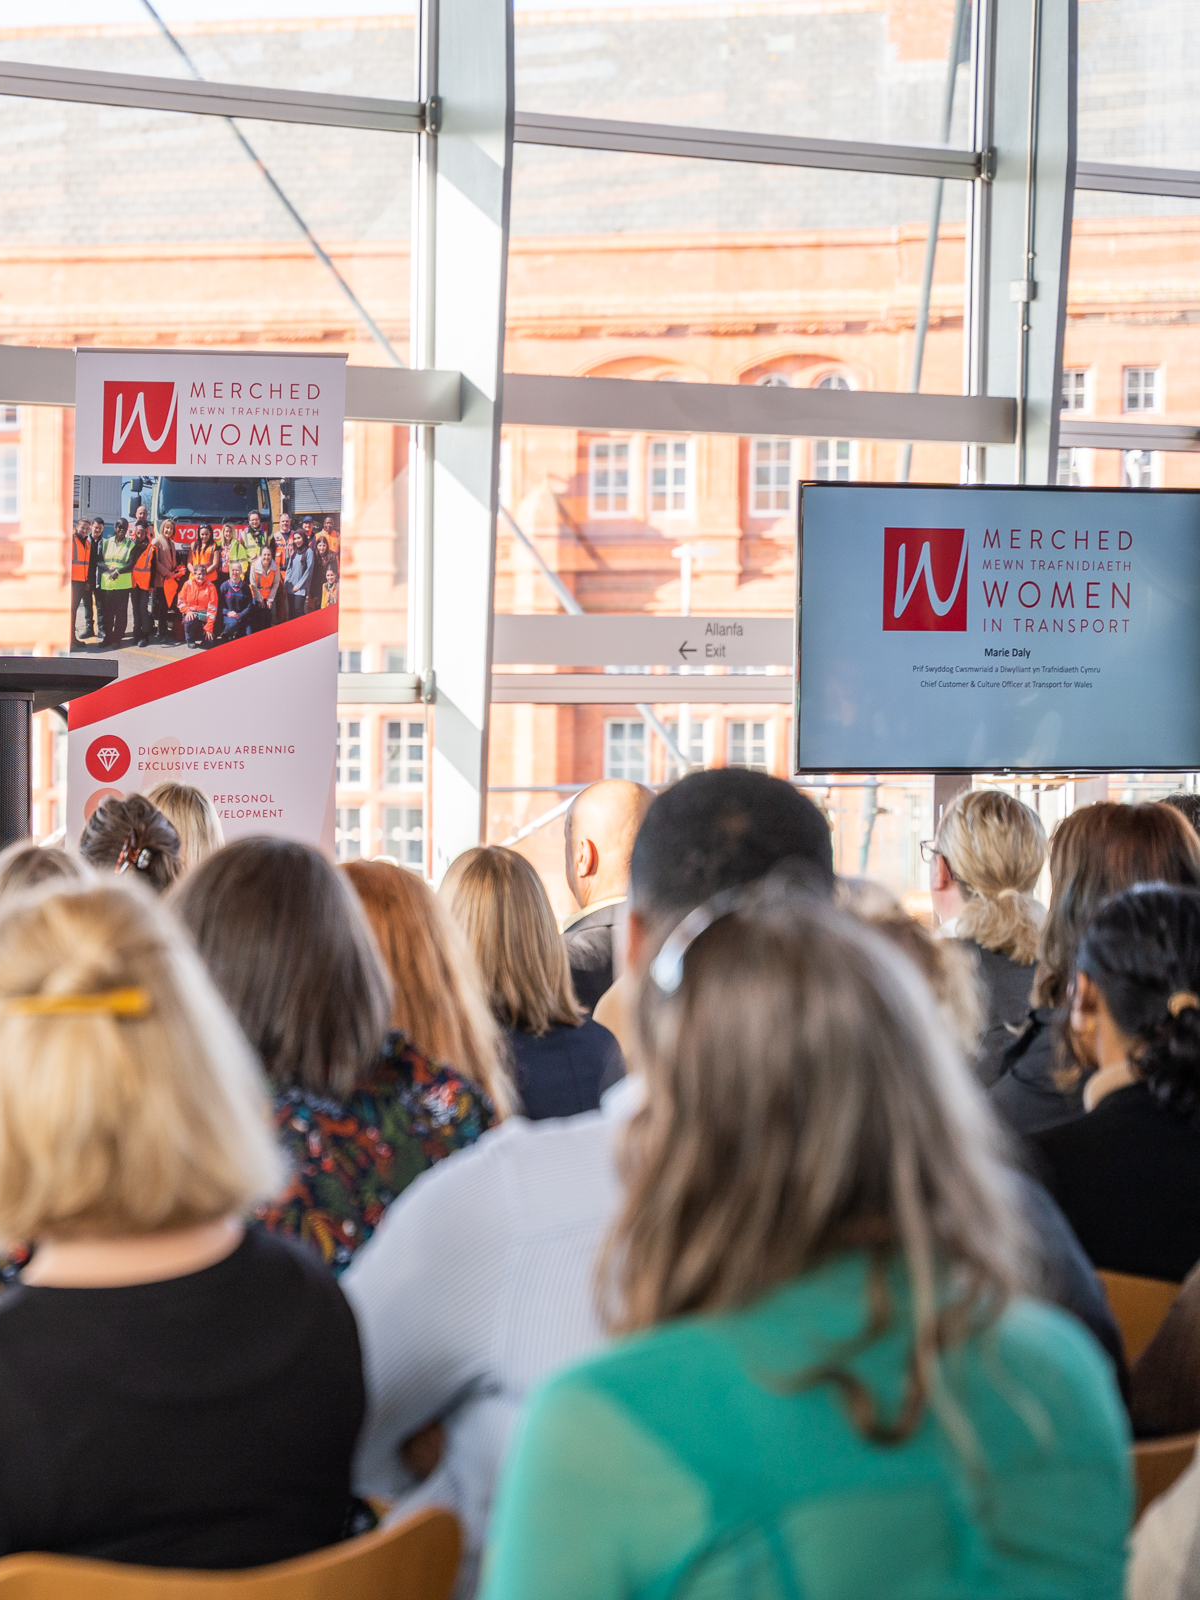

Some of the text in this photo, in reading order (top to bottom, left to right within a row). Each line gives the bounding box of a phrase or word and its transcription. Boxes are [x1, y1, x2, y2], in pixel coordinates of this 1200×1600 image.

[190, 382, 320, 400] MERCHED
[190, 407, 319, 417] MEWN TRAFNIDIAETH
[190, 424, 319, 446] WOMEN
[190, 454, 318, 466] IN TRANSPORT
[983, 528, 1133, 550] MERCHED
[982, 560, 1131, 571] MEWN TRAFNIDIAETH
[983, 580, 1131, 609] WOMEN
[705, 622, 743, 637] Allanfa
[983, 618, 1129, 633] IN TRANSPORT
[705, 644, 726, 658] Exit
[984, 648, 1031, 658] Marie Daly
[925, 665, 953, 674] Swyddog
[1080, 666, 1100, 674] Cymru
[1032, 681, 1062, 689] Transport
[138, 745, 296, 756] DIGWYDDIADAU ARBENNIG
[138, 761, 245, 771] EXCLUSIVE EVENTS
[213, 794, 274, 804] PERSONOL
[217, 809, 283, 818] VELOPMENT
